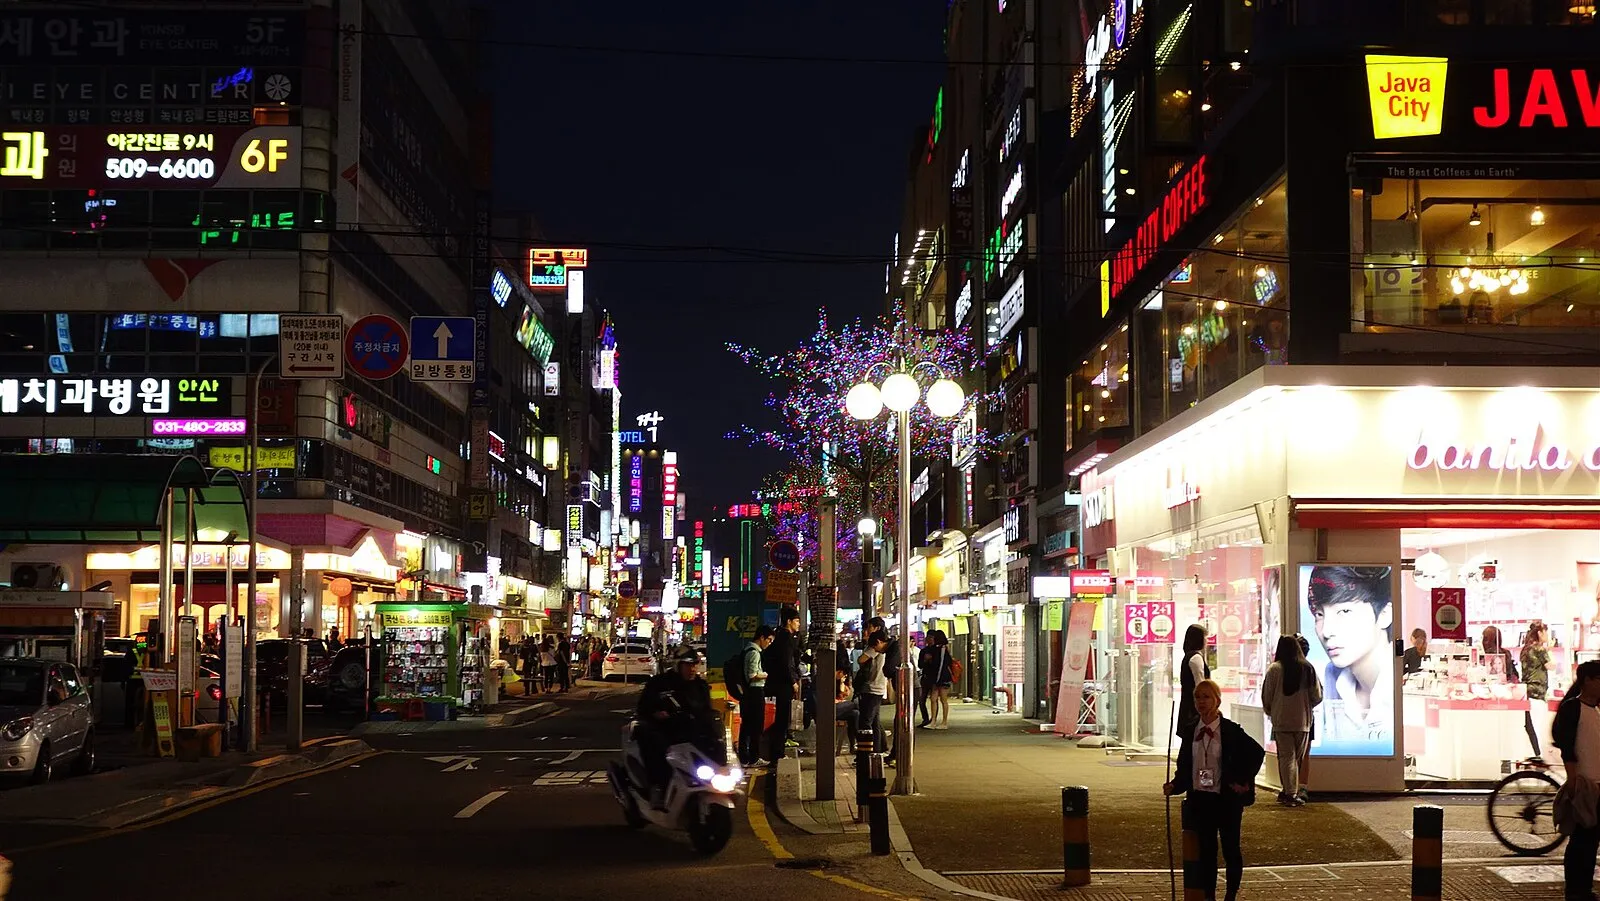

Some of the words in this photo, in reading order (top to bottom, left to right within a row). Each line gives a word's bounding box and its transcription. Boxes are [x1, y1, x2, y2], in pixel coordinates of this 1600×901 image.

[246, 17, 287, 44] 5F
[140, 38, 165, 50] EYE
[168, 38, 219, 50] CENTER
[1380, 72, 1431, 93] Java
[1389, 95, 1431, 122] City
[106, 133, 180, 152] 야간진료
[182, 133, 215, 152] 9시
[239, 139, 289, 173] 6F
[105, 157, 215, 180] 509-6600
[1387, 167, 1406, 177] The
[1409, 167, 1430, 177] Best
[1433, 167, 1471, 177] Coffees
[1474, 169, 1486, 177] on
[1489, 167, 1515, 177] Earth
[1136, 207, 1160, 270] CITY
[1162, 154, 1207, 242] COFFEE
[353, 341, 401, 353] 주정차금지
[413, 363, 473, 379] 일방통행
[178, 379, 220, 403] 안산
[154, 421, 246, 433] 031-480-2833
[619, 431, 645, 443] OTEL
[1407, 421, 1572, 471] banila
[215, 551, 266, 566] HOUE
[1437, 591, 1461, 605] 2+1
[1129, 606, 1148, 618] 2+1
[1152, 604, 1172, 615] 2+1
